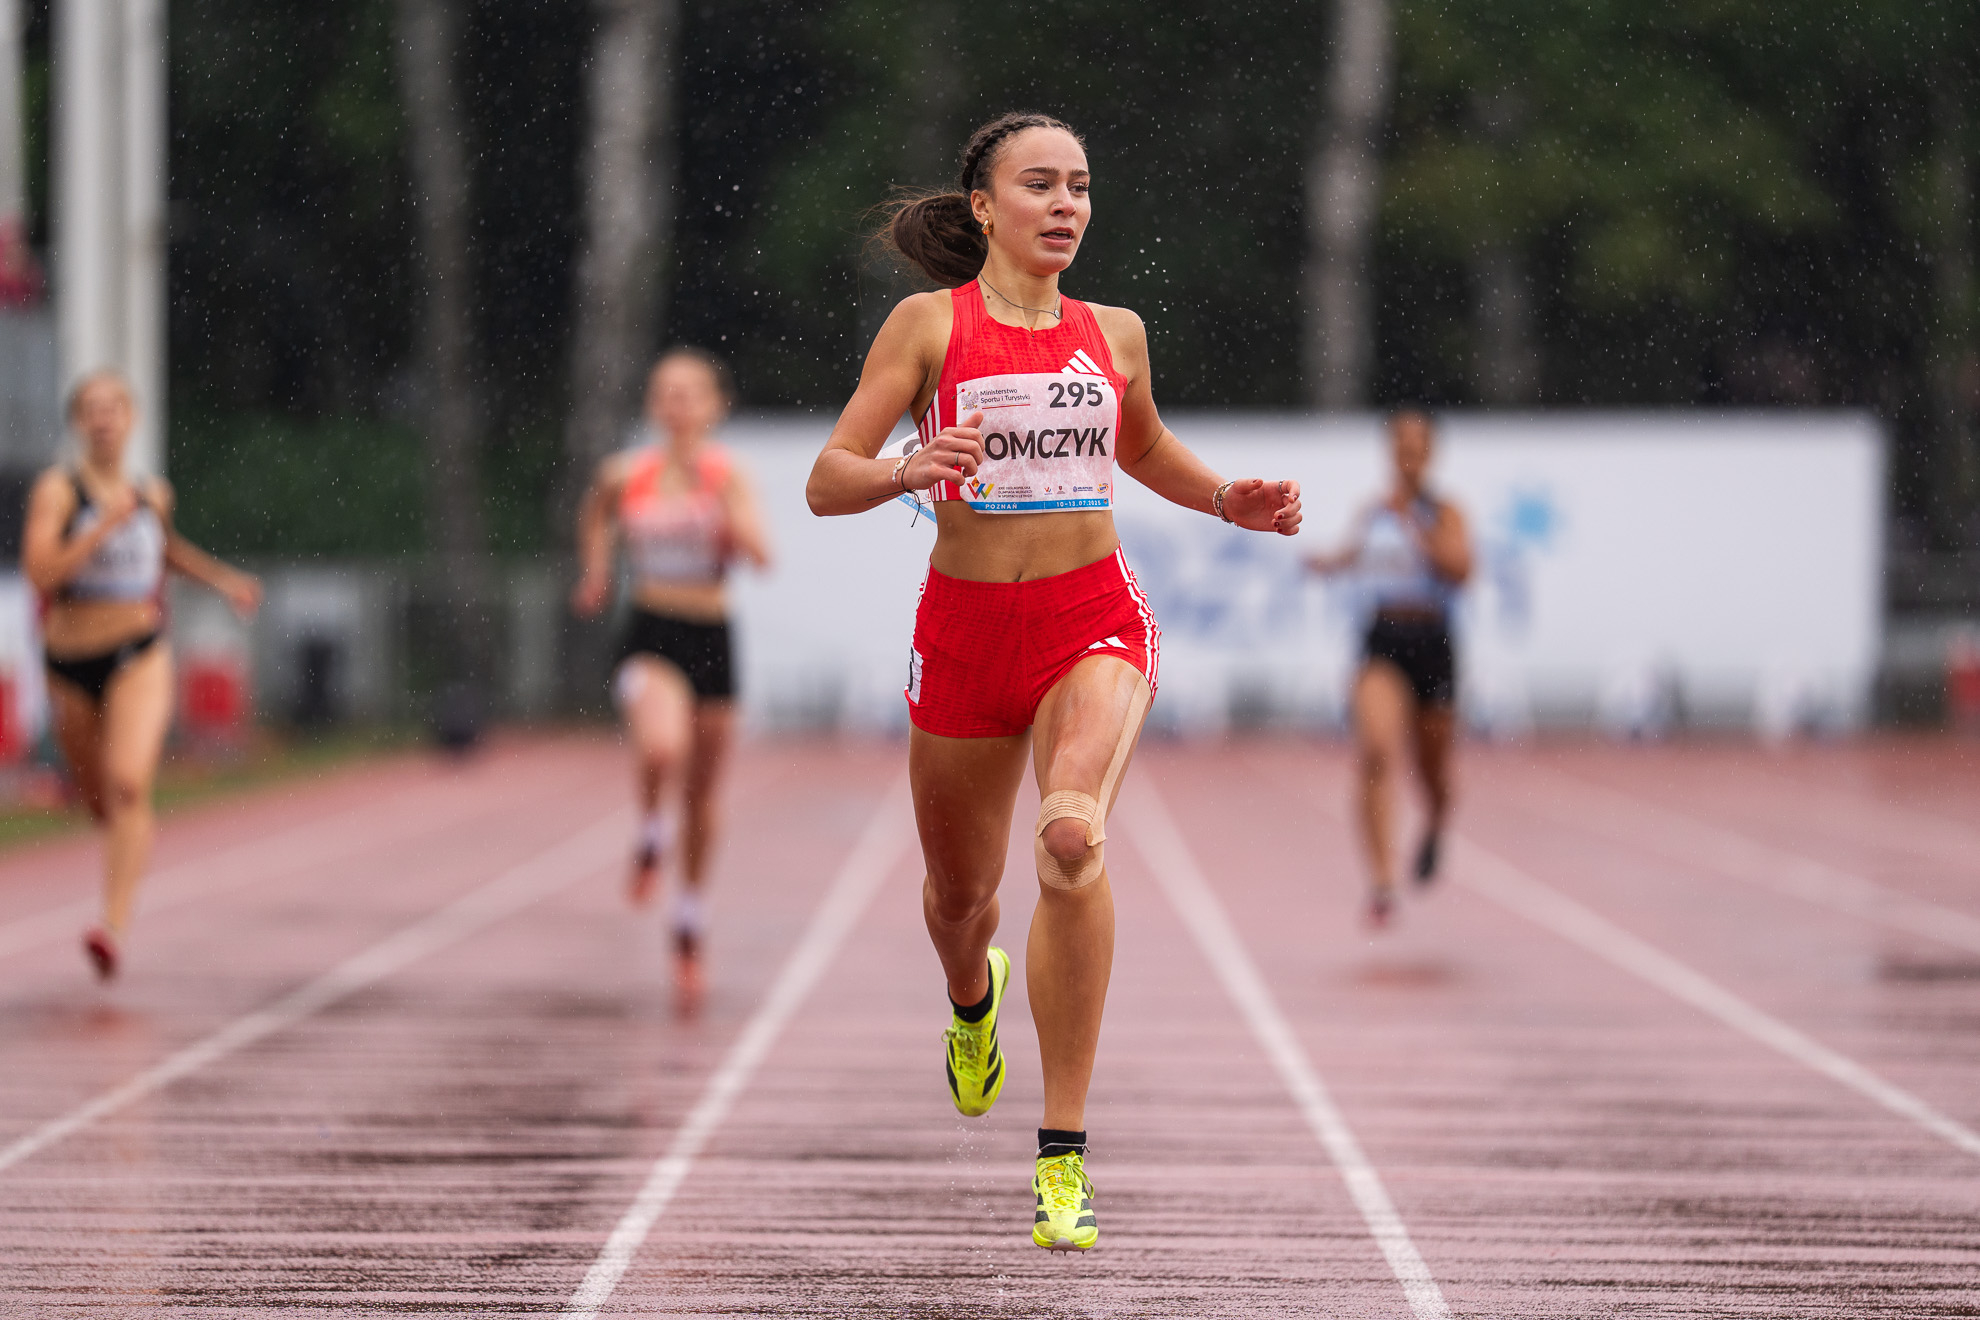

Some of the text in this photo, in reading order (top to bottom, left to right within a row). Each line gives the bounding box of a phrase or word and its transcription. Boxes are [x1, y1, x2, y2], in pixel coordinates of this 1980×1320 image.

[980, 388, 1018, 396] Ministerstwo
[980, 396, 1001, 404] Sportu
[1005, 394, 1031, 403] Turystyki
[1048, 382, 1103, 408] 295
[981, 427, 1110, 461] OMCZYK
